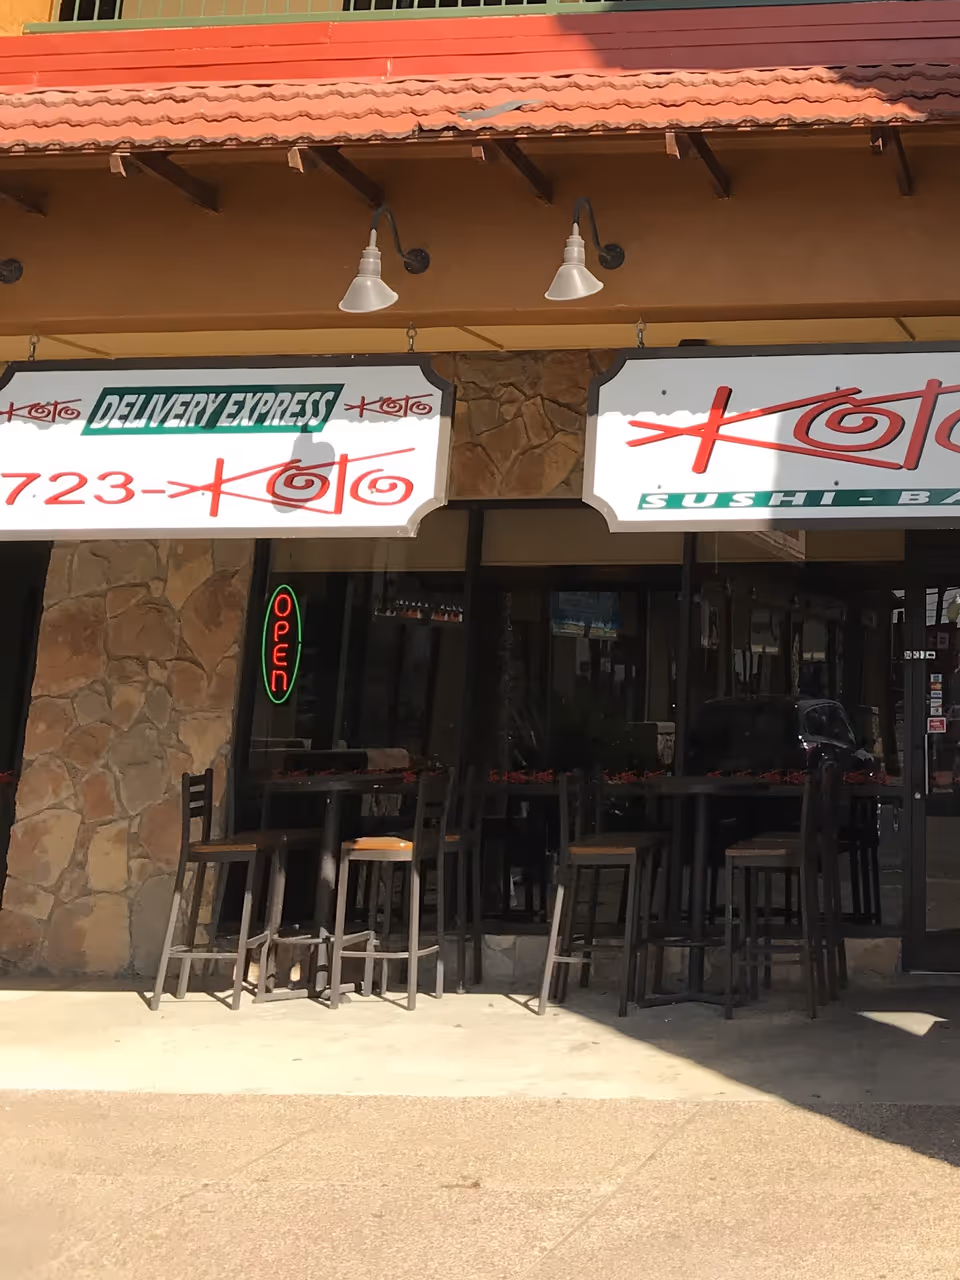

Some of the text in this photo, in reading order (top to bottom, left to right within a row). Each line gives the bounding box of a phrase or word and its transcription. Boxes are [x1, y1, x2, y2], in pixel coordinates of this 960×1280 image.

[89, 393, 222, 429] DELIVERY
[223, 390, 336, 427] EXPRESS
[271, 594, 292, 691] OPEN
